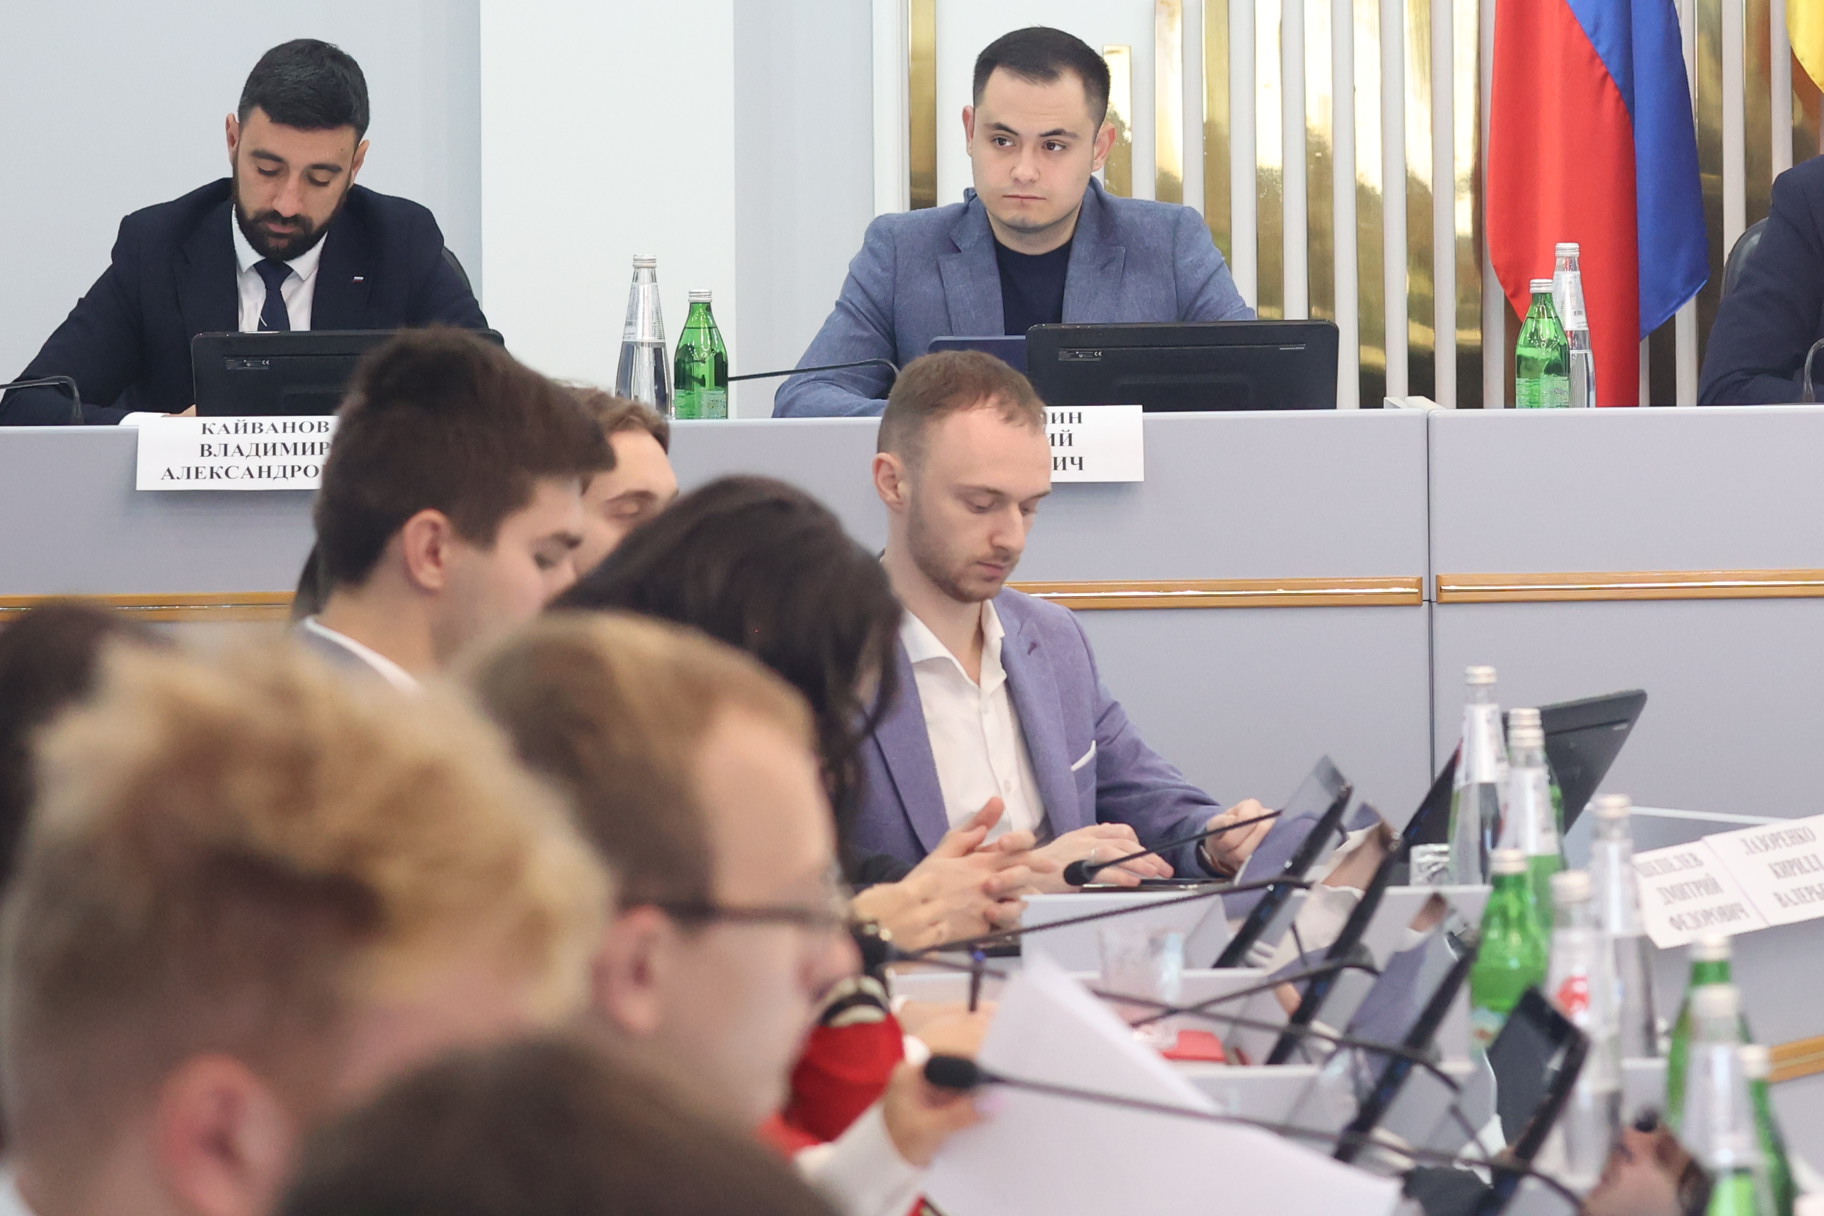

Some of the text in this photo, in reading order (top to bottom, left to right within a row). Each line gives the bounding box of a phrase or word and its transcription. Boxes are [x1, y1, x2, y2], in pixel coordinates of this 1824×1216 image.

[201, 419, 330, 435] КАЙВАНОВ
[199, 441, 330, 459] ВЛАДИМИР
[160, 464, 322, 481] АЛЕКСАНДРО
